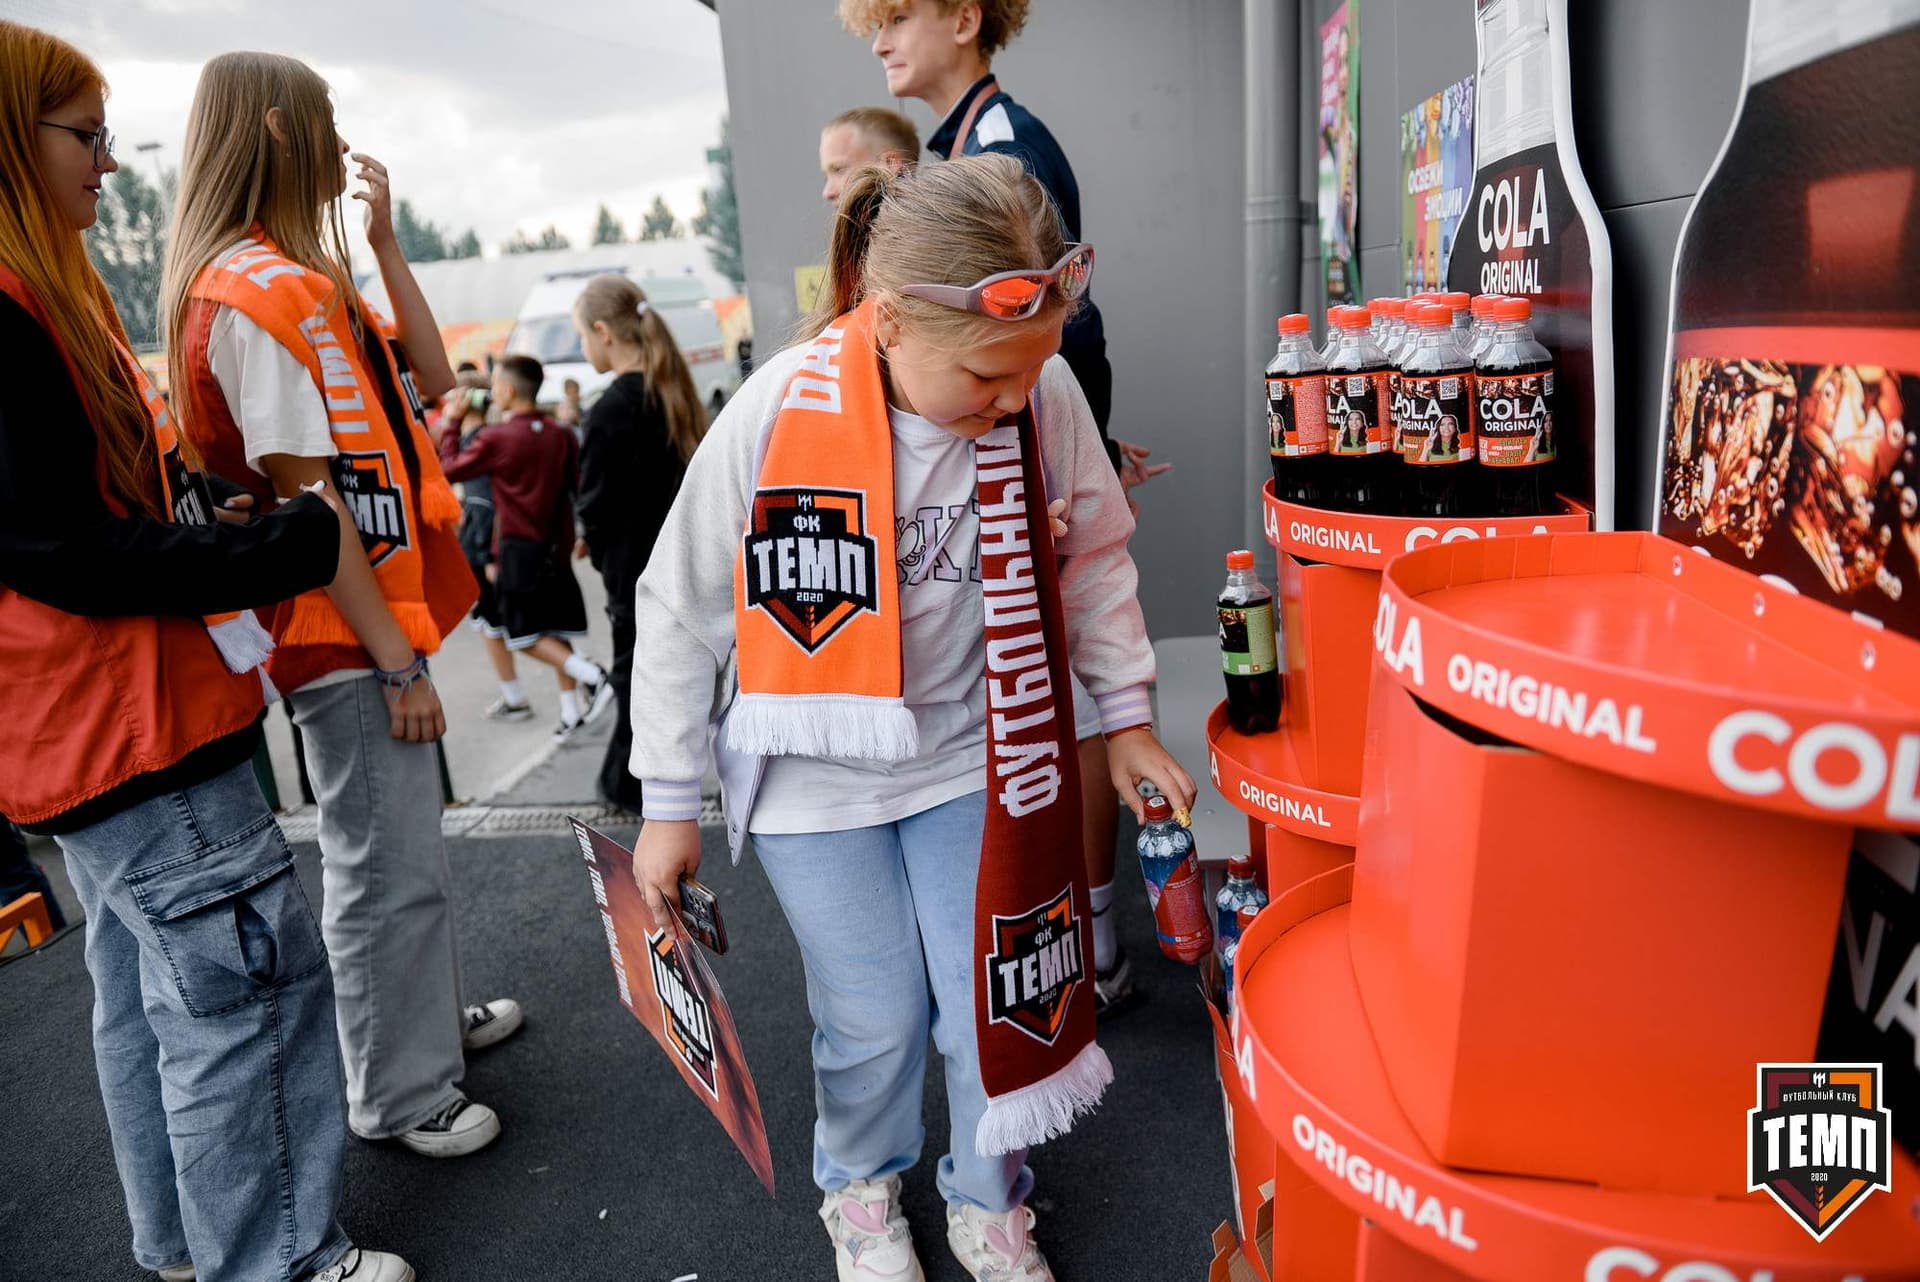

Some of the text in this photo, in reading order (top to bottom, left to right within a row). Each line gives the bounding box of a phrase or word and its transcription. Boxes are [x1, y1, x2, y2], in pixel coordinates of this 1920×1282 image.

[1478, 168, 1550, 253] COLA
[1480, 258, 1542, 295] ORIGINAL
[1327, 394, 1351, 415] LA
[1402, 398, 1443, 420] OLA
[1480, 395, 1547, 421] COLA
[1485, 418, 1543, 432] ORIGINAL
[343, 491, 400, 537] МП
[793, 515, 821, 533] ФК
[1263, 500, 1281, 543] LA
[1290, 521, 1382, 555] ORIGINAL
[752, 537, 867, 598] ТЕМП
[796, 592, 824, 603] 2020
[1374, 592, 1920, 823] OLA ORIGINAL COL
[1239, 780, 1332, 828] ORIGINAL
[1035, 926, 1053, 947] ФК
[998, 930, 1078, 1008] ТЕМП
[1292, 1113, 1479, 1251] ORIGINAL
